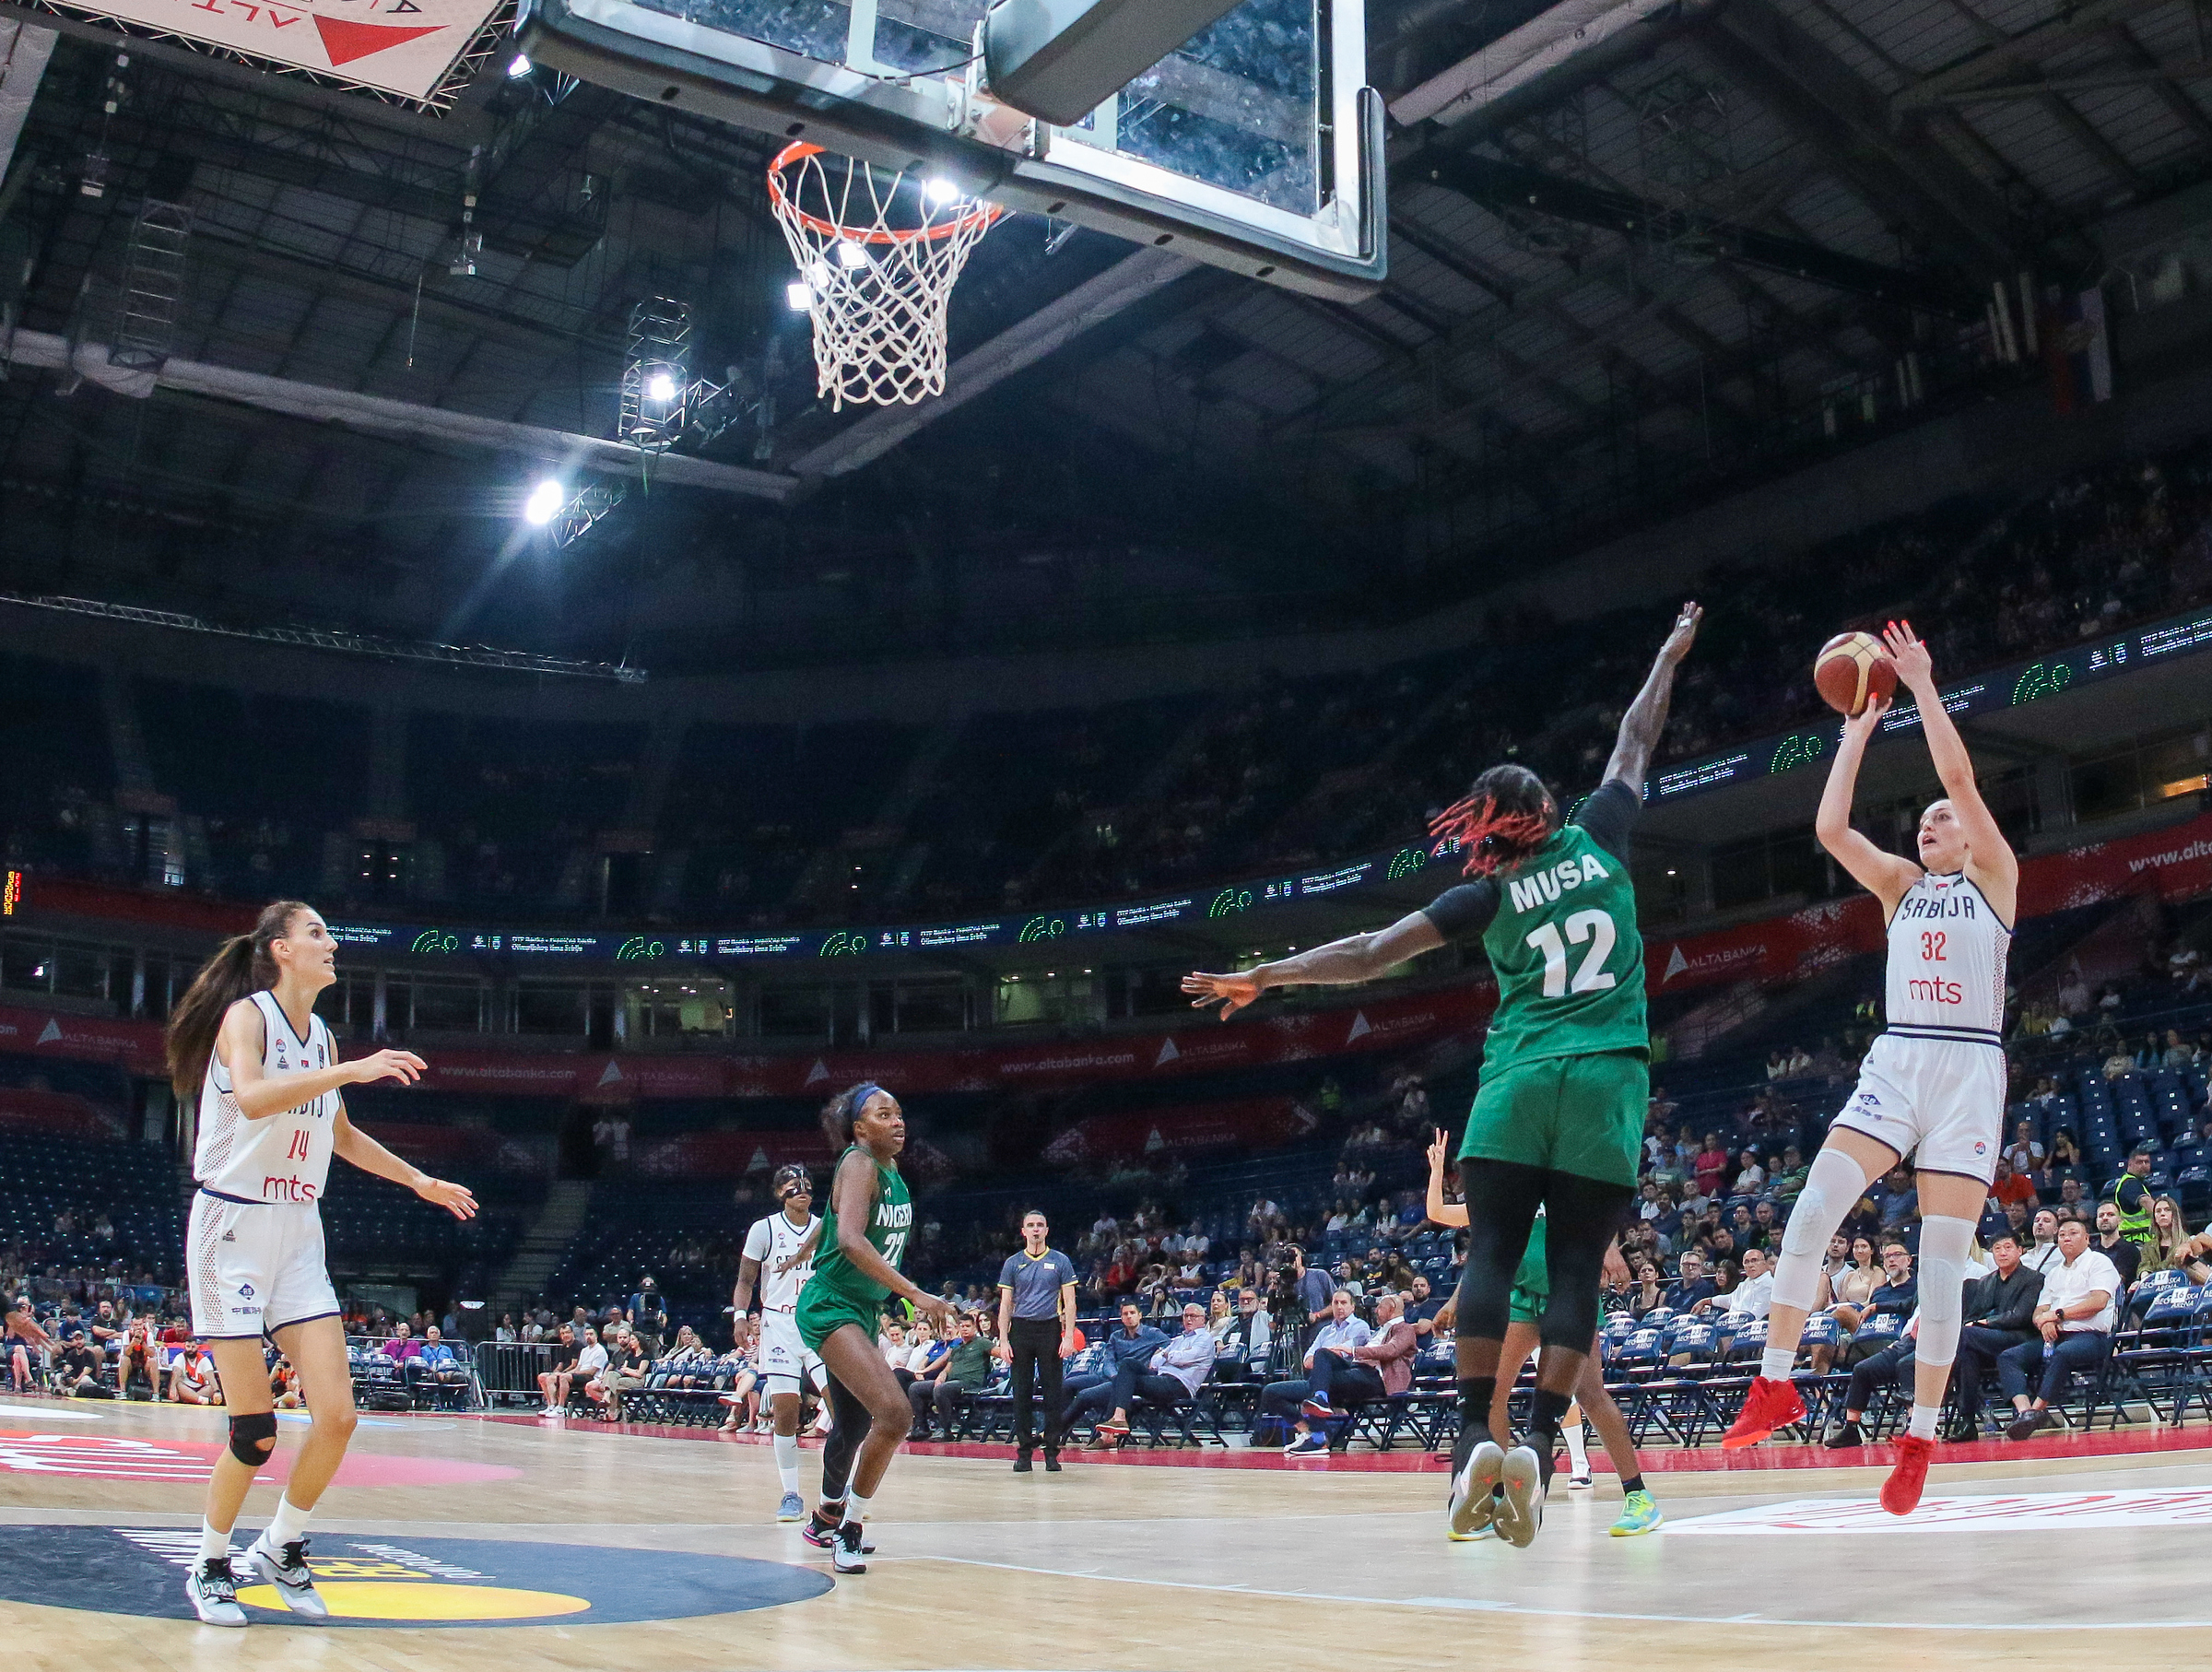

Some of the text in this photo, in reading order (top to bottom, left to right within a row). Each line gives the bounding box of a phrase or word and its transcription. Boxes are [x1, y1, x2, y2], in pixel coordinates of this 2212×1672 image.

[1509, 854, 1609, 913] MUSA
[1900, 895, 1975, 920] SRBIJA
[1525, 909, 1617, 997] 12
[1689, 944, 1767, 968] ALTABANKA
[1921, 931, 1947, 961] 32
[1909, 975, 1962, 1005] mts
[287, 1129, 311, 1162] 14
[263, 1174, 317, 1202] mts
